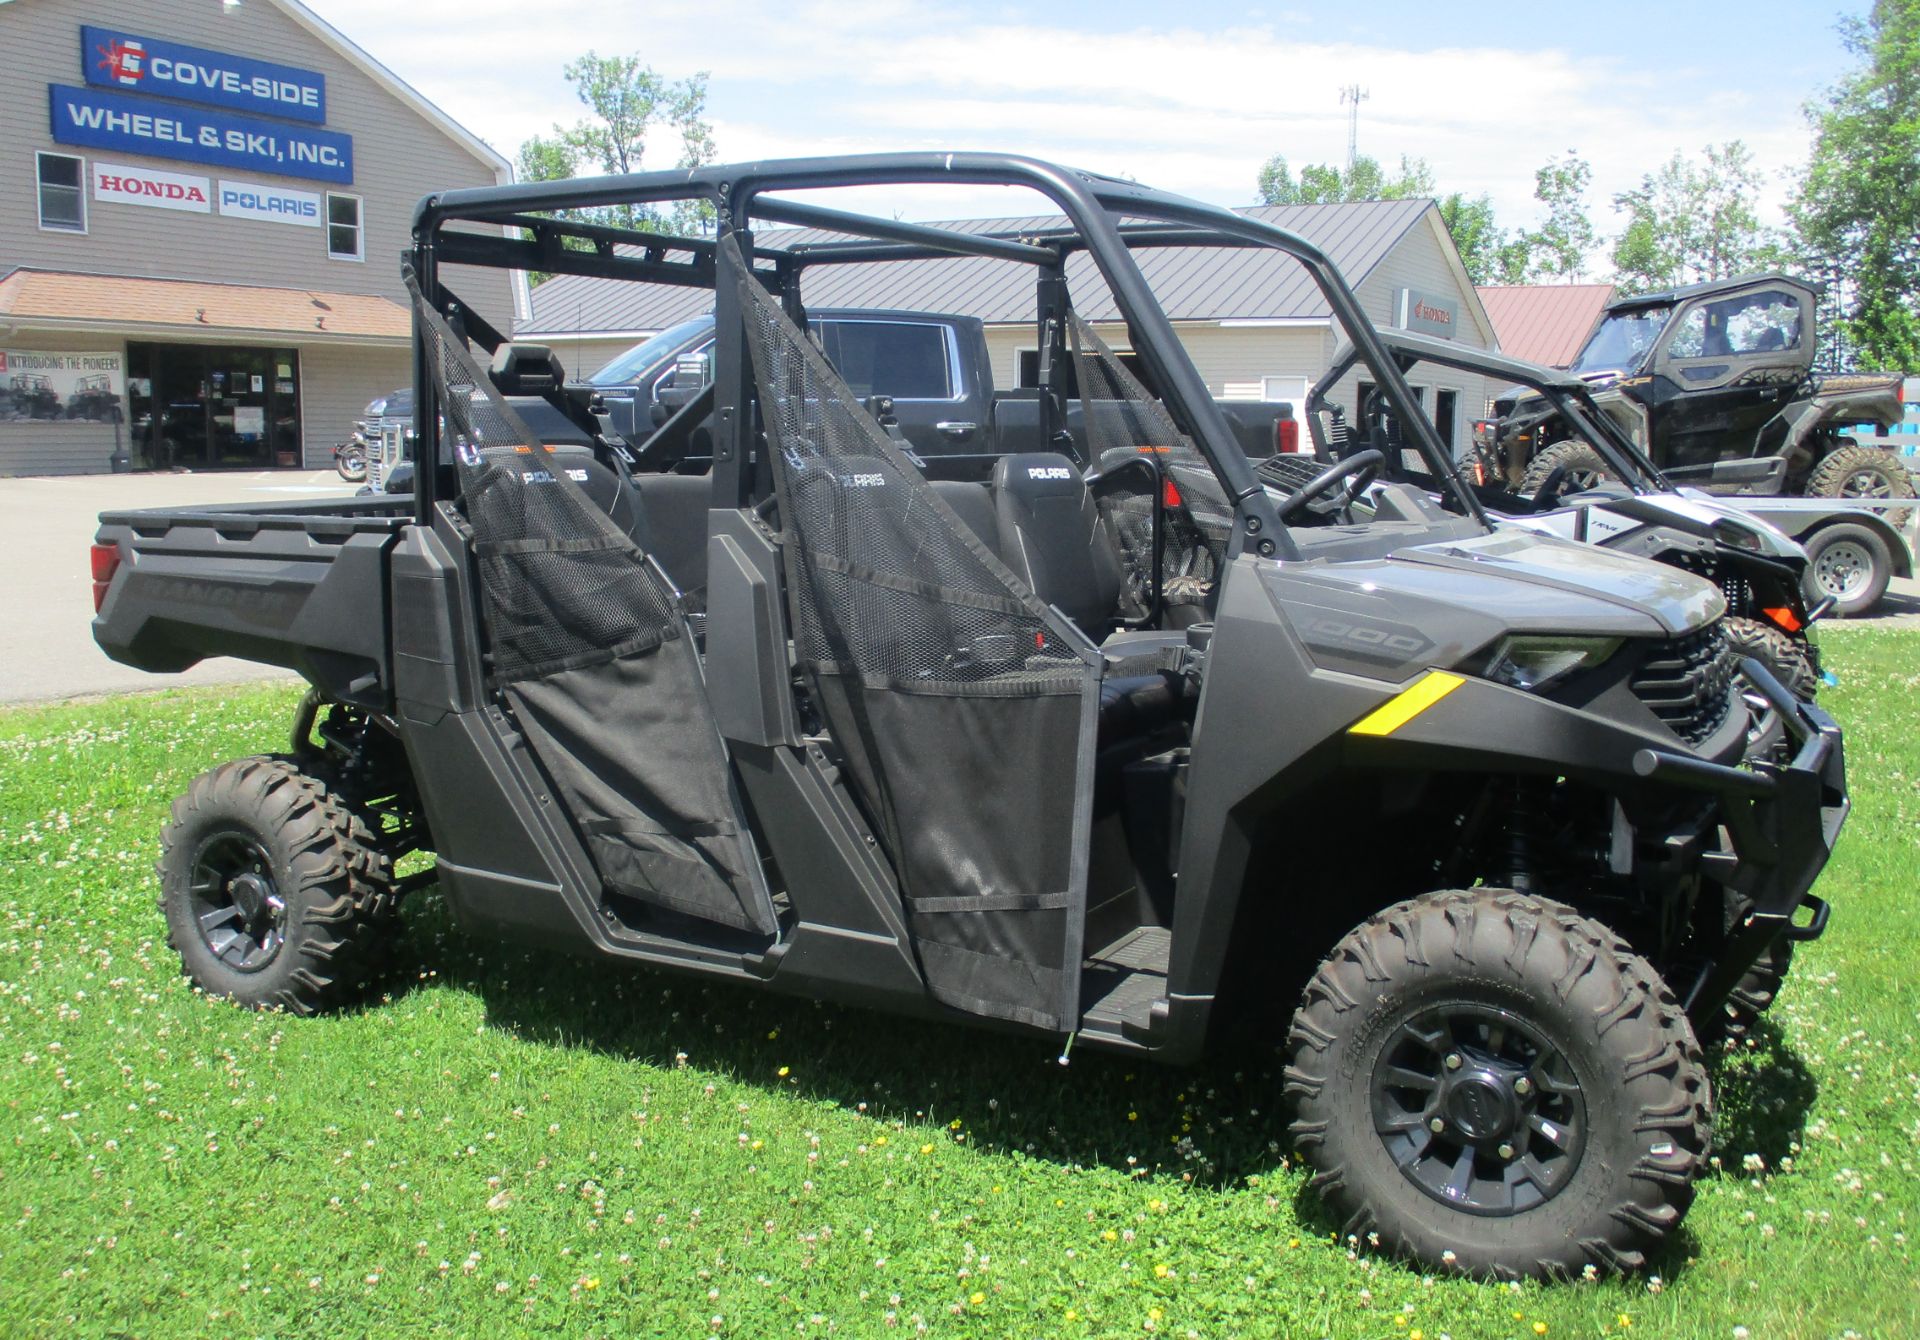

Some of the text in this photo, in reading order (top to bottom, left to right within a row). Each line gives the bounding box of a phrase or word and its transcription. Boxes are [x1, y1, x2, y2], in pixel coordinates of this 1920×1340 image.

[151, 58, 318, 107] COVE-SIDE
[68, 104, 345, 167] WHEEL & SKI, INC.
[99, 175, 206, 202] HONDA
[223, 191, 317, 217] POLARIS
[1423, 306, 1450, 324] HONDA
[8, 355, 63, 369] INTRODUCING
[66, 357, 80, 369] THE
[83, 358, 119, 370] PIONEERS
[522, 469, 588, 484] POLRIS
[1028, 468, 1070, 479] POLARIS
